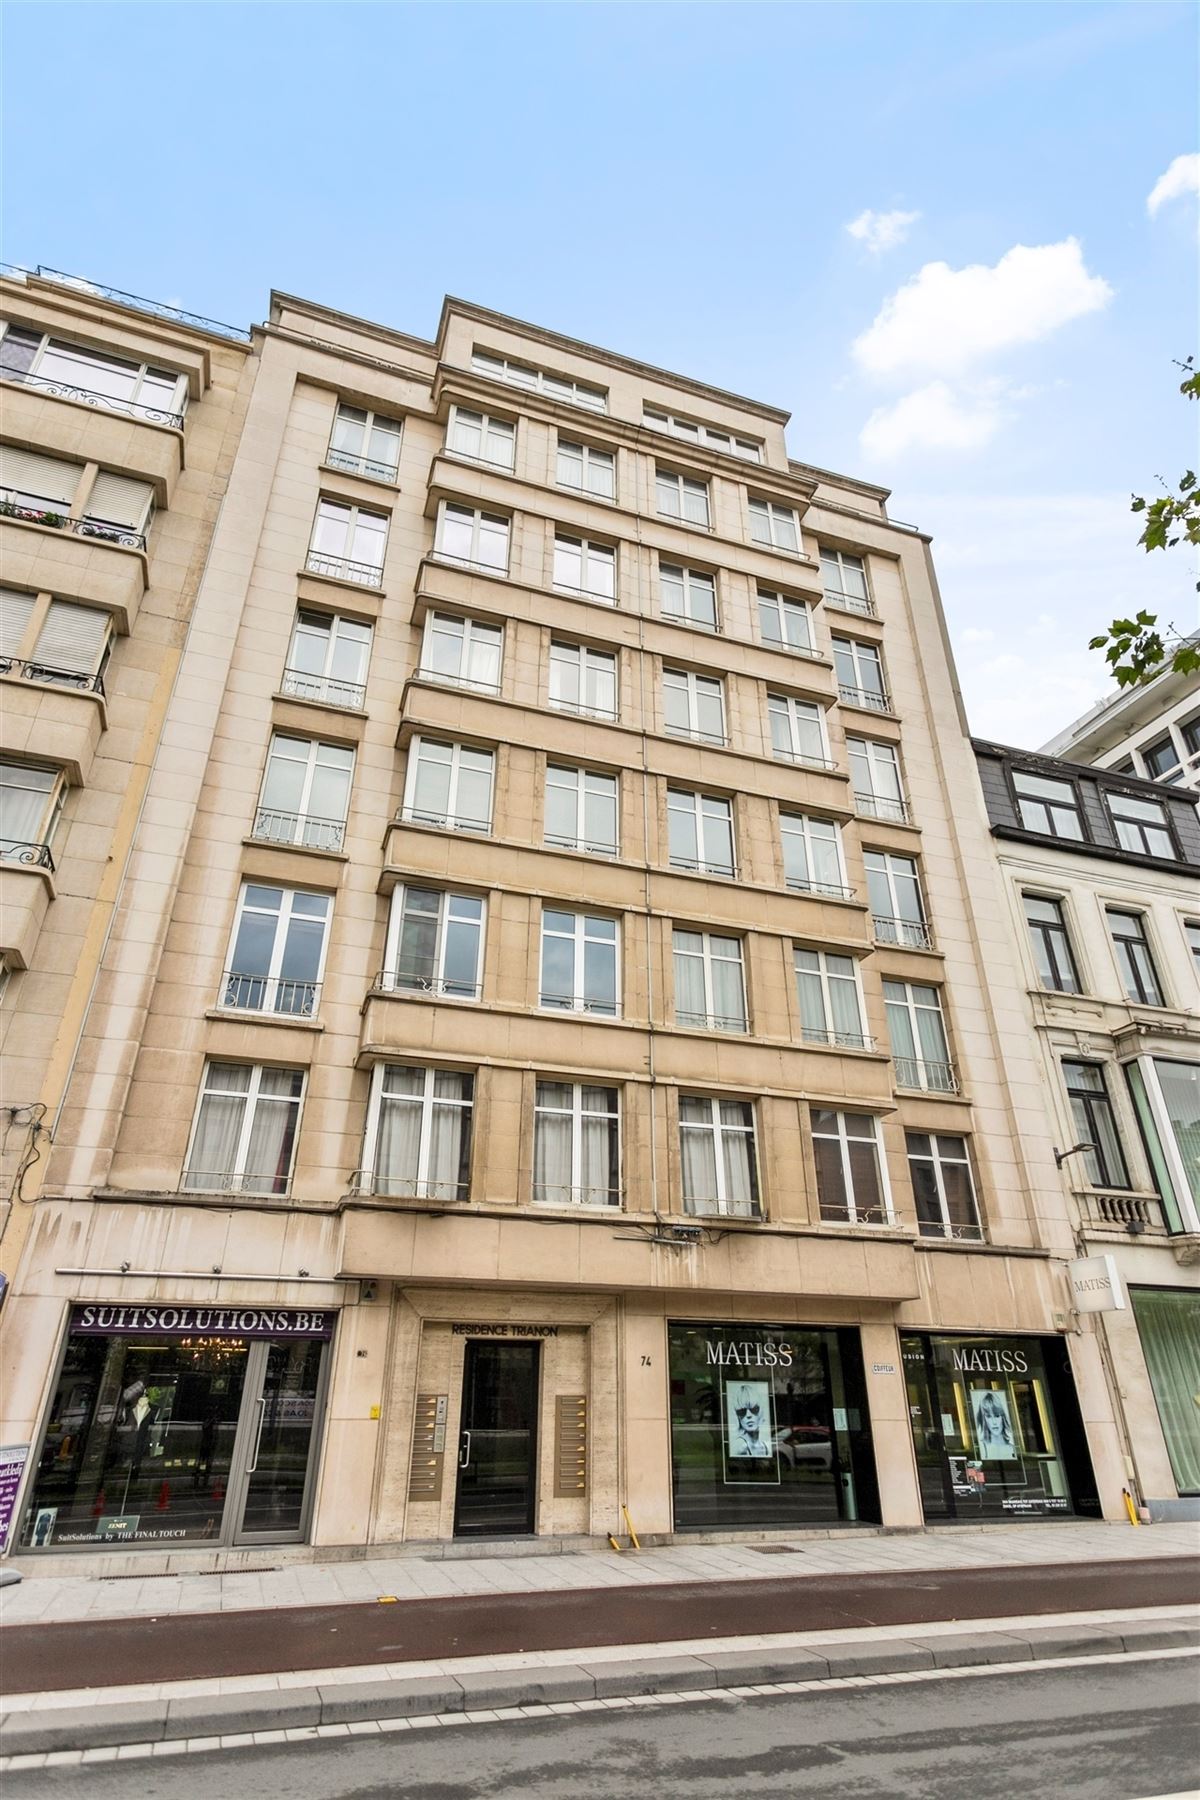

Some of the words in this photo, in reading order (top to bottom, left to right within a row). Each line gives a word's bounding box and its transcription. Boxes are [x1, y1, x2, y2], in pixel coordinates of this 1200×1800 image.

[1074, 1276, 1111, 1293] MATISS
[80, 1306, 324, 1332] SUITSOLUTIONS.BE
[452, 1323, 508, 1337] RESIDENCE
[511, 1325, 559, 1338] TRIANON
[640, 1355, 652, 1367] 74
[705, 1340, 793, 1367] MATISS
[951, 1348, 1028, 1373] MATISS
[159, 1529, 187, 1538] TOUCH
